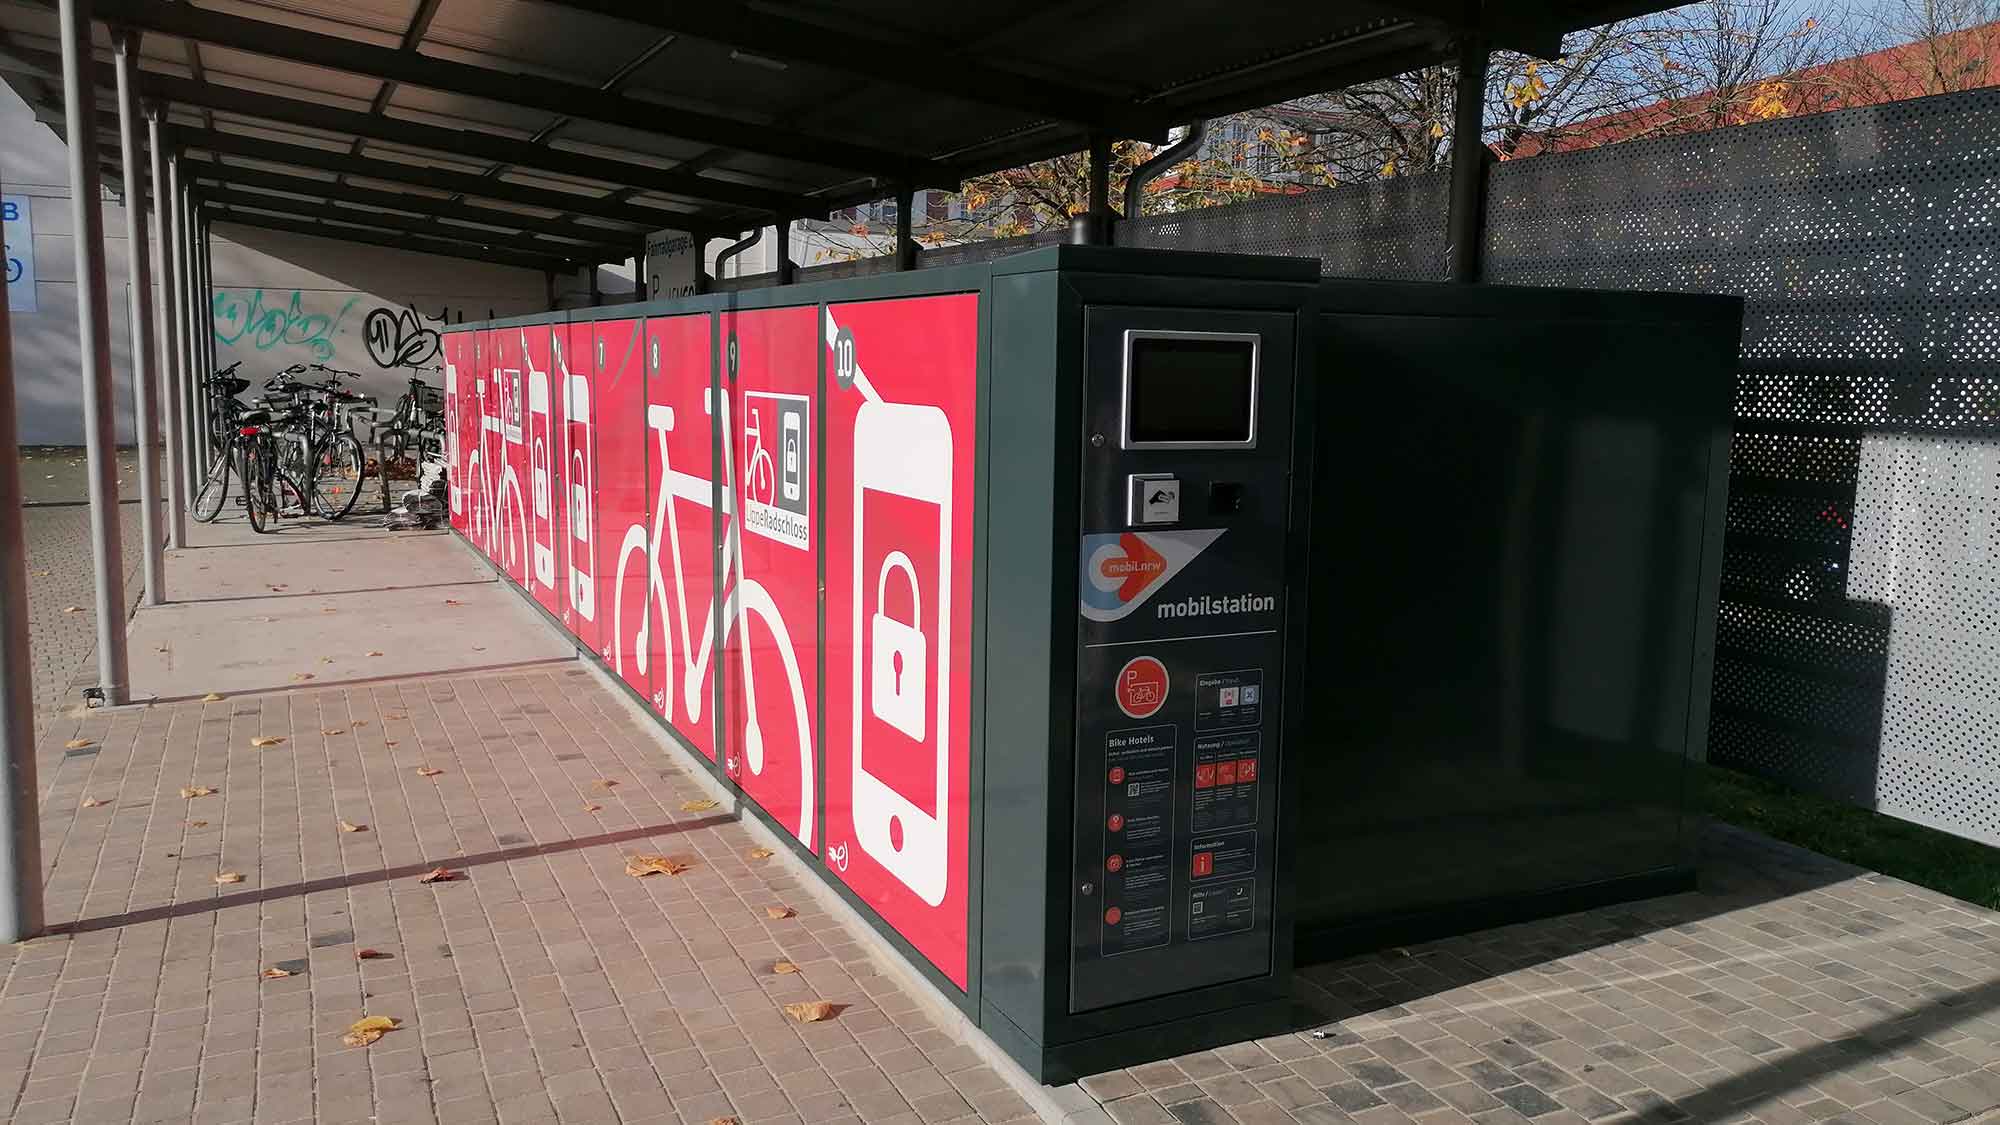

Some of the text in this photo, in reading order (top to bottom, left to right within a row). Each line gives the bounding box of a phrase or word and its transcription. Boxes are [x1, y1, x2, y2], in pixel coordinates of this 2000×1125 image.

[652, 342, 658, 369] 8
[729, 341, 736, 372] 9
[836, 338, 853, 377] 10
[1109, 558, 1161, 574] mobil.nrw
[1157, 593, 1275, 619] mobilstation
[1108, 735, 1154, 748] Bike Hotels
